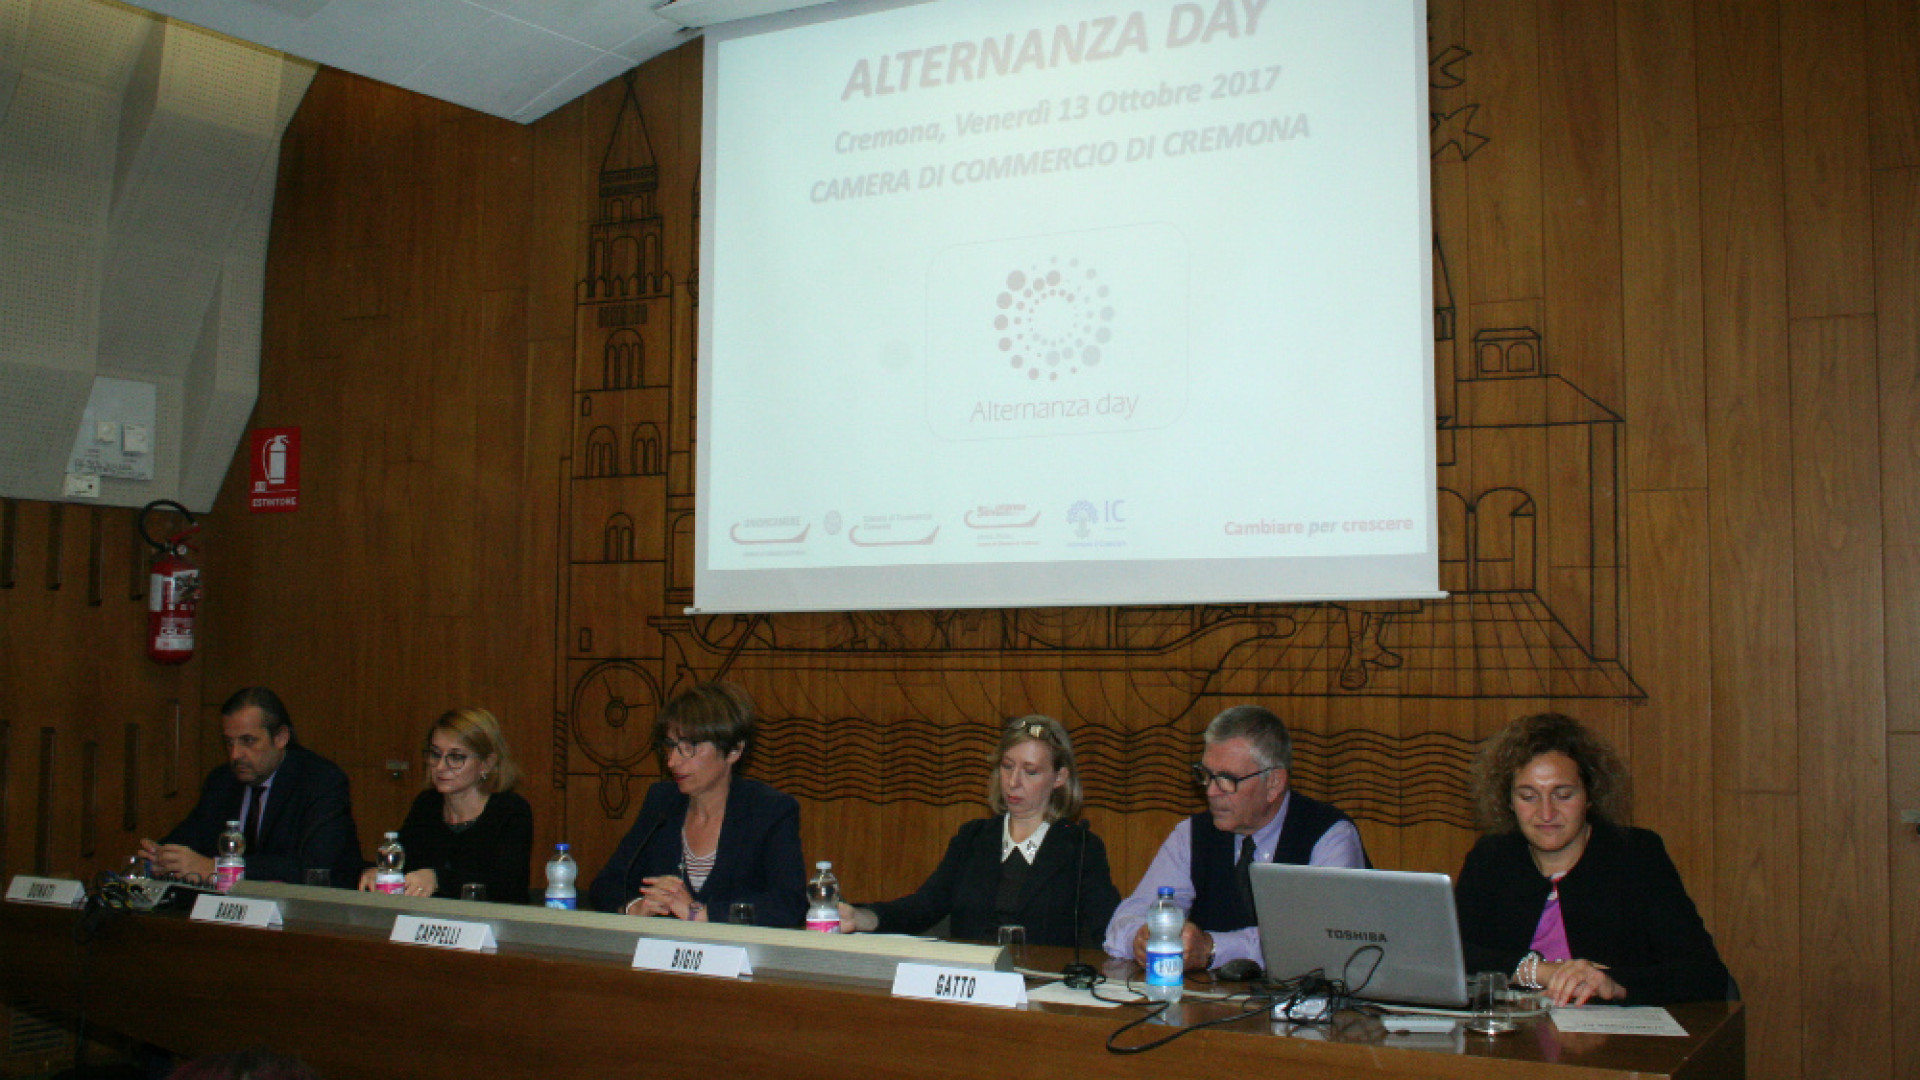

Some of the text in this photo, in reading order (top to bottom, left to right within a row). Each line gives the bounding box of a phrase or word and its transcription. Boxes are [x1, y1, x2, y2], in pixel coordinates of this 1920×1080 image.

[840, 0, 1270, 101] ALTERNANZA DAY
[834, 65, 1283, 154] Cremona, Venerdì 13 Ottobre 2017
[810, 113, 1311, 204] CAMERA DI COMMERCIO DI CREMONA
[969, 393, 1139, 423] Alternanza day
[252, 496, 297, 508] ESTINTORE
[1105, 499, 1126, 523] IC
[1224, 517, 1415, 537] Cambiare per crescere
[215, 902, 248, 920] BARONI
[415, 923, 462, 944] CAPPELLI
[1325, 928, 1388, 942] TOSHIBA
[672, 948, 703, 970] BIGIO
[935, 974, 976, 998] GATTO
